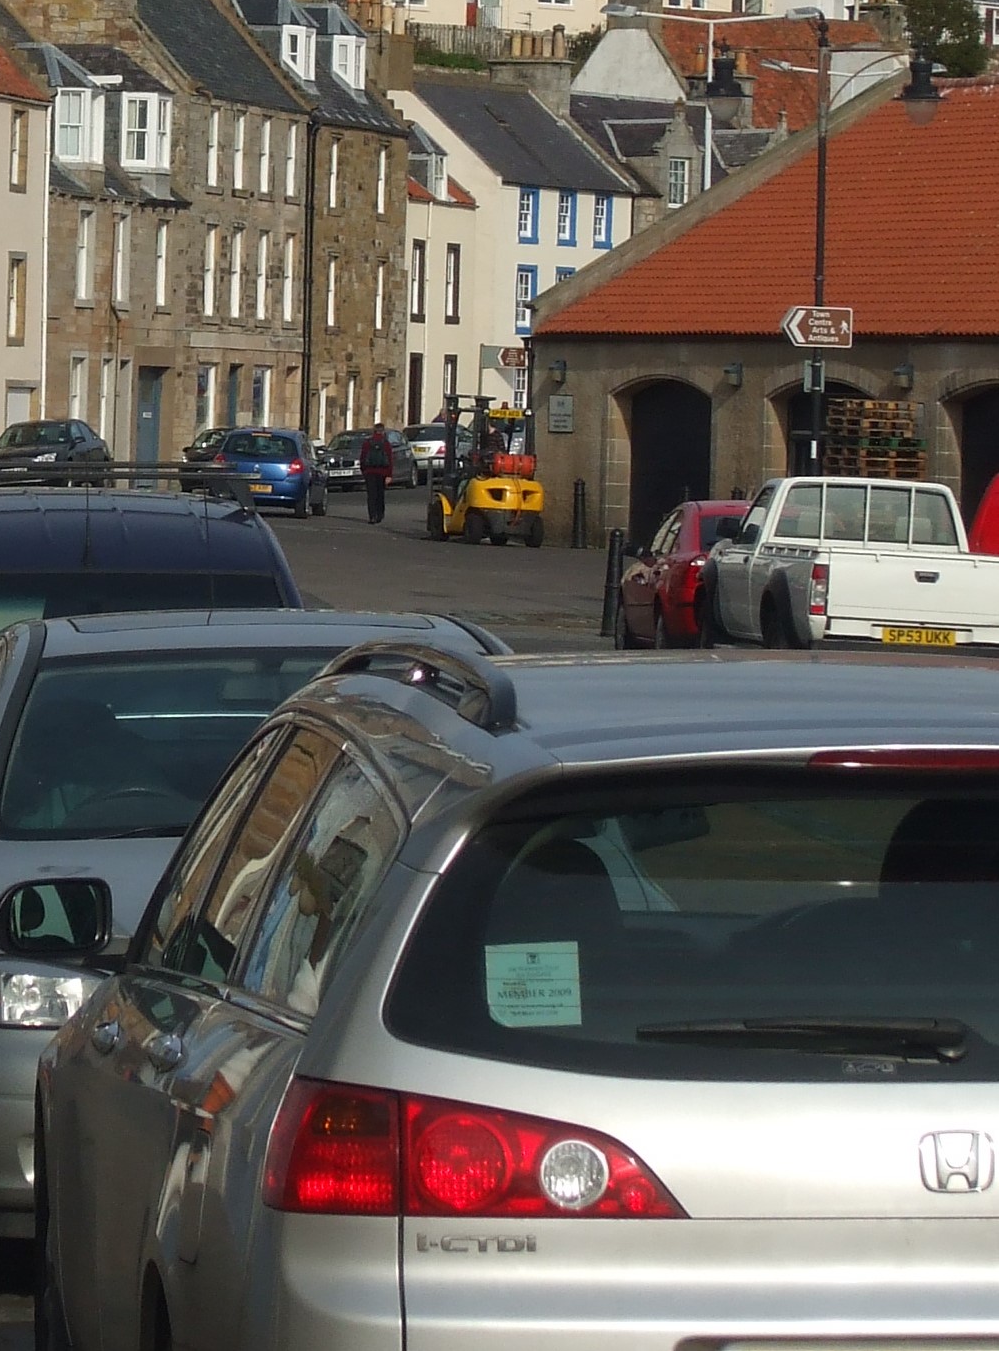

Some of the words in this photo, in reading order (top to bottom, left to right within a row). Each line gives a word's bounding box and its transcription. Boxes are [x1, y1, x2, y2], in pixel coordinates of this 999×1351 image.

[812, 310, 831, 318] Town
[808, 318, 833, 326] Centre
[808, 334, 839, 342] Antiques
[889, 629, 922, 643] SP53
[925, 631, 951, 644] UKK
[497, 990, 545, 999] MEMBER
[548, 988, 572, 997] 2009
